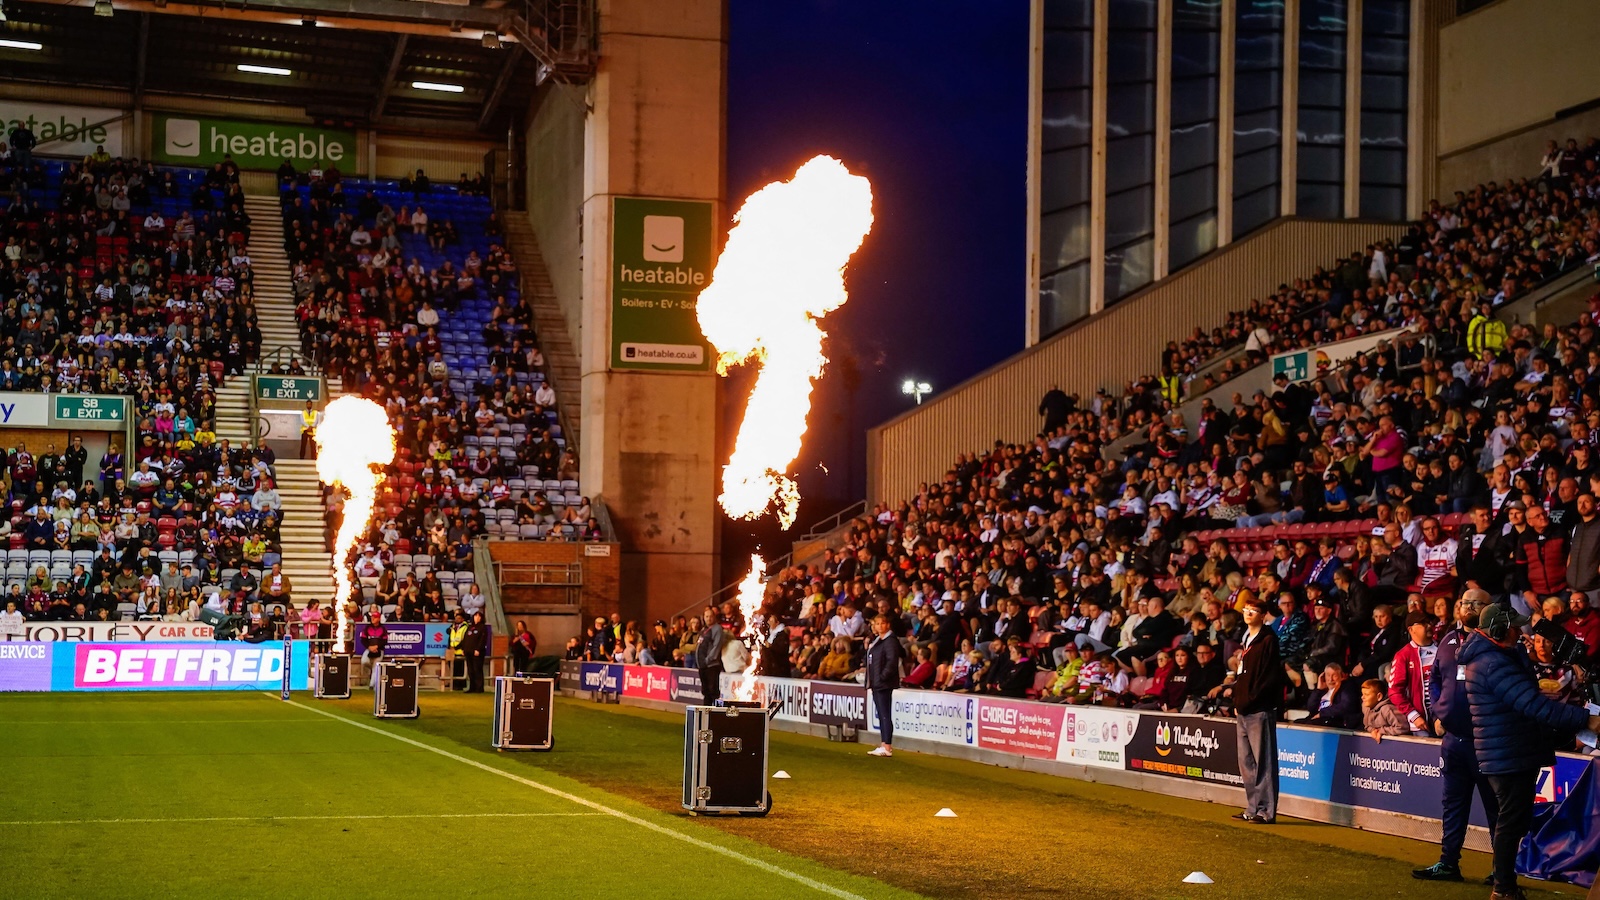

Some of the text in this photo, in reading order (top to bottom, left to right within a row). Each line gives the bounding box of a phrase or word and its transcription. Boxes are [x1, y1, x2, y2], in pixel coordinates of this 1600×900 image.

[0, 114, 107, 145] atable
[210, 126, 344, 161] heatable
[621, 264, 704, 285] heatable
[621, 298, 696, 309] Boilers EV Sol
[637, 348, 698, 359] heatable.co.uk
[276, 389, 300, 398] EXIT
[281, 379, 296, 389] S6
[0, 403, 15, 423] y
[77, 408, 103, 418] EXIT
[159, 627, 186, 637] CAR
[0, 645, 46, 658] ERVICE
[83, 649, 284, 682] BETFRED
[787, 685, 808, 717] HIRE
[813, 692, 865, 721] SEAT UNIQUE
[895, 701, 961, 718] owen groundwork
[980, 705, 1018, 725] CHORLEY
[895, 718, 961, 737] & construction ltd
[1173, 726, 1219, 757] NutraPrep's
[1307, 752, 1316, 765] of
[1349, 753, 1371, 769] Where
[1371, 759, 1413, 777] opportunity
[1278, 766, 1310, 780] ancashire
[1349, 774, 1402, 794] lancashire.ac.uk
